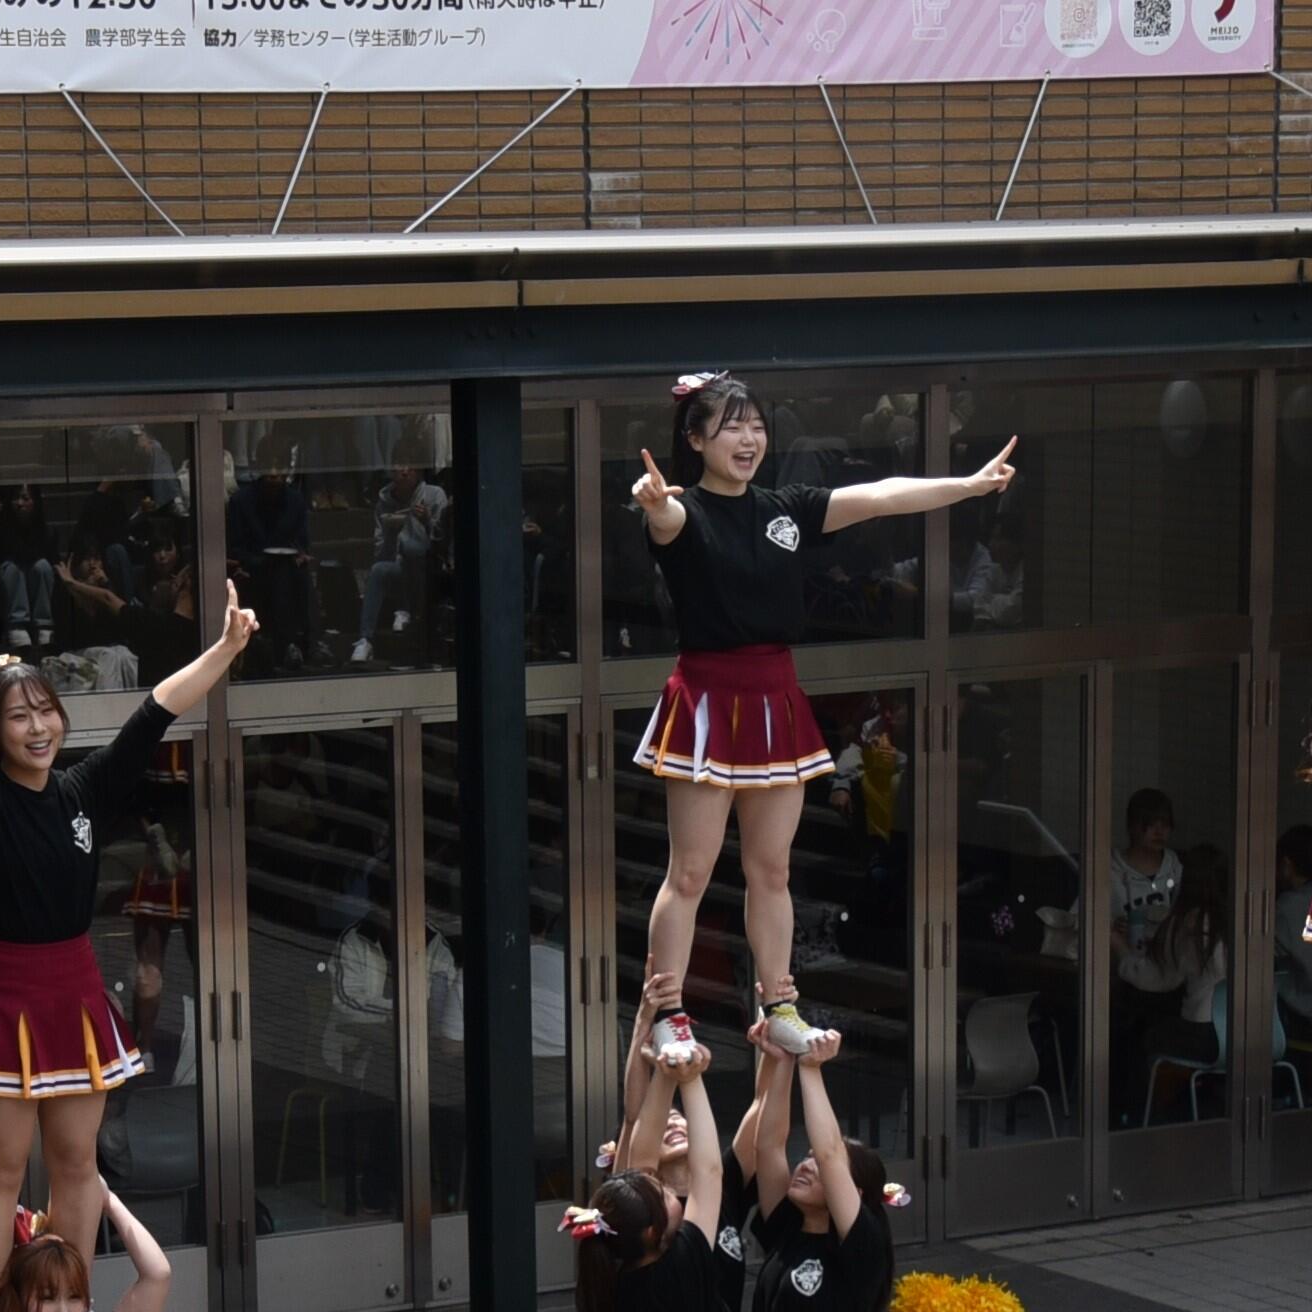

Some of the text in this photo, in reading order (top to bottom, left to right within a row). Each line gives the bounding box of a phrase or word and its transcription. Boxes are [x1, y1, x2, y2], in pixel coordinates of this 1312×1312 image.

[85, 27, 186, 48] 農学部学生会
[1210, 26, 1240, 35] MEIJO
